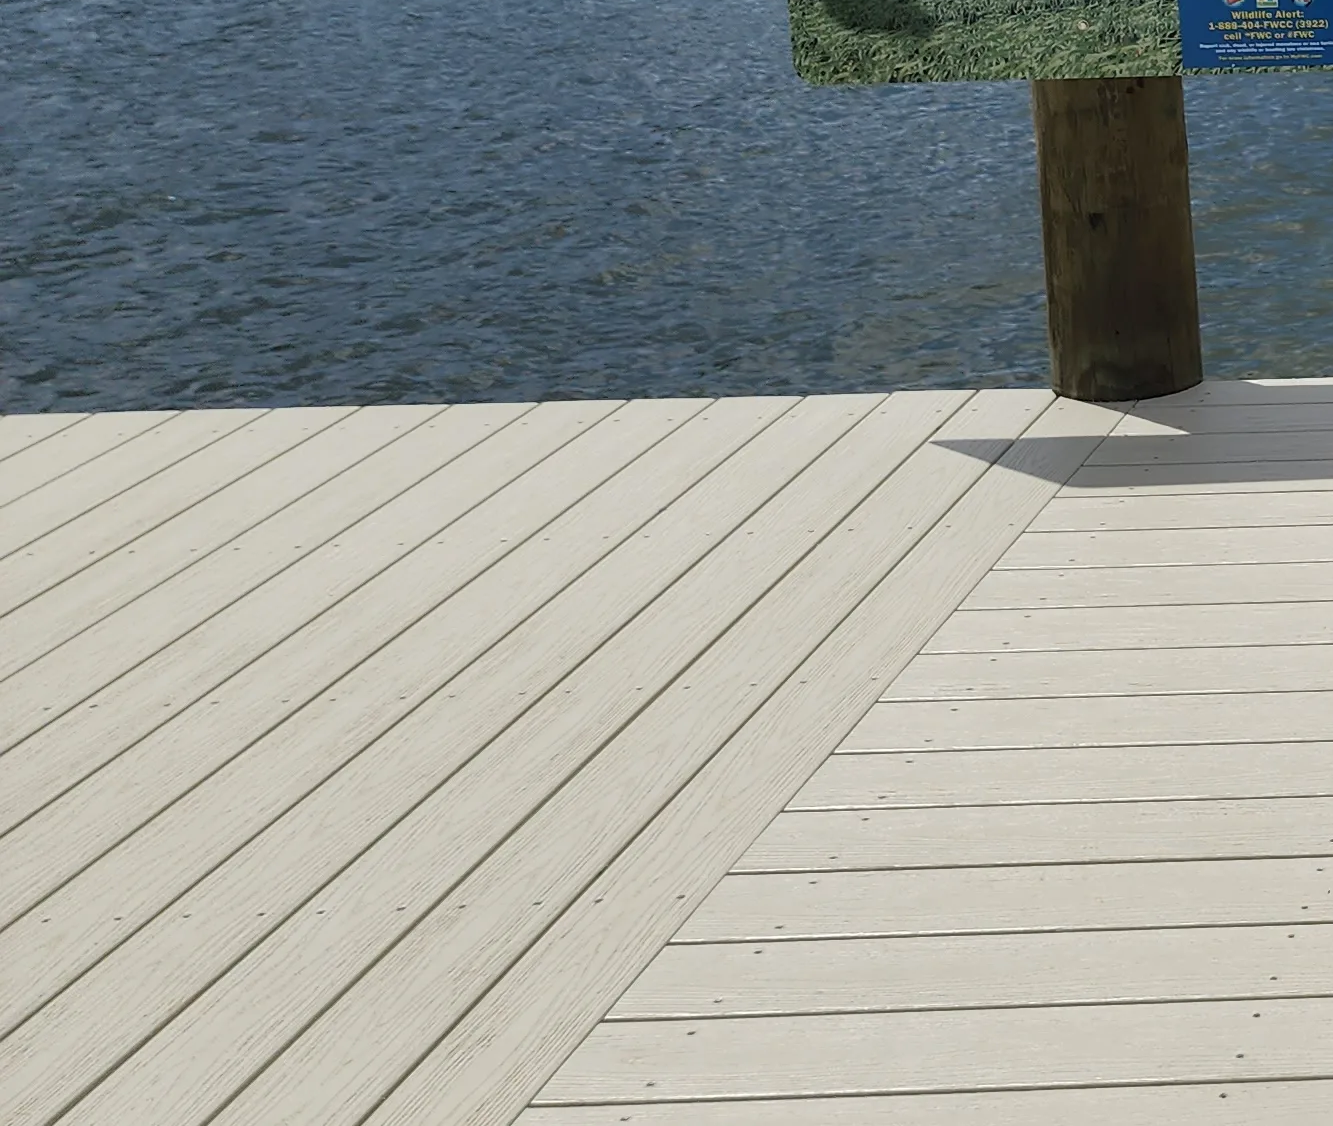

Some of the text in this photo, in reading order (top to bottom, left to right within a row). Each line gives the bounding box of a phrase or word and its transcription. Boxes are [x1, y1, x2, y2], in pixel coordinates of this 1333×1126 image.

[1231, 10, 1304, 20] Wildlife Alert:
[1209, 20, 1329, 31] 1-888-404-FWCC (3922)
[1224, 32, 1241, 40] cell
